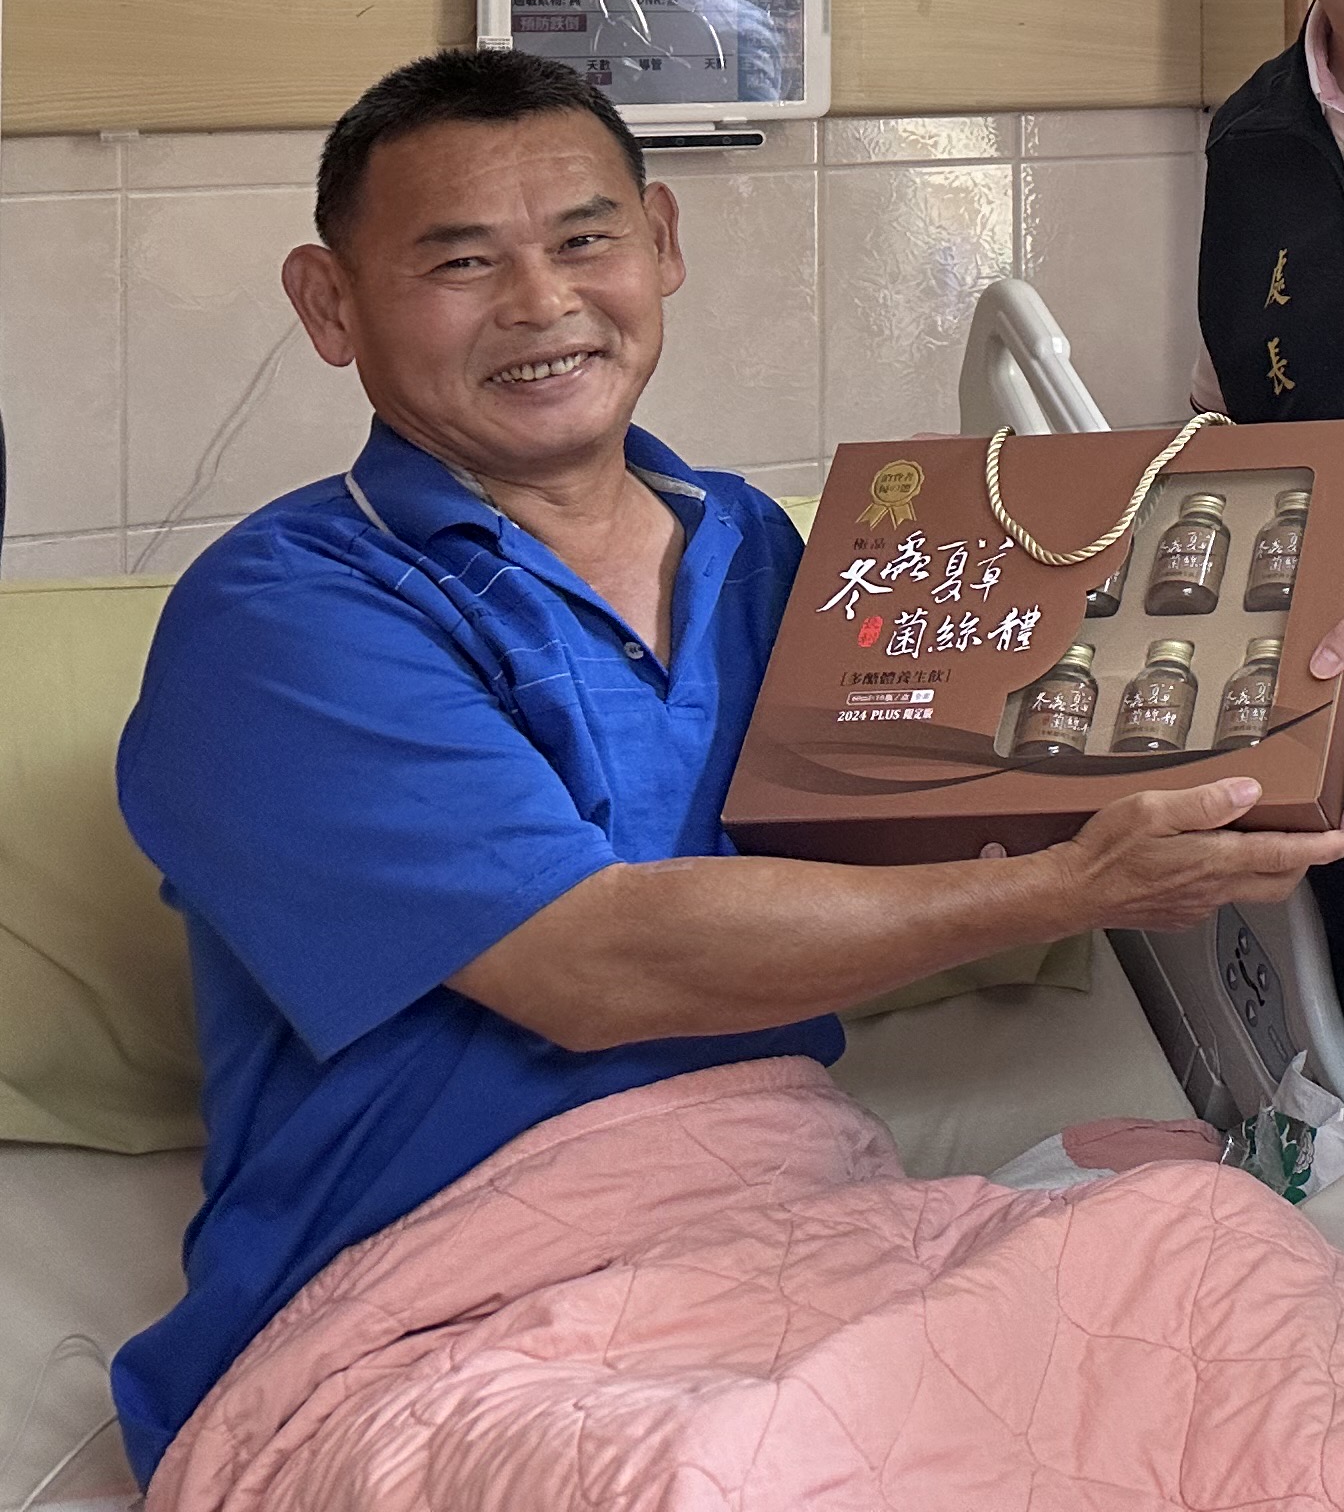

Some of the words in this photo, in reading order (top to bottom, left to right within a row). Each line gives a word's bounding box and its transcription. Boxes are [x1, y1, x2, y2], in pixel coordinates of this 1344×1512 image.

[1264, 247, 1296, 396] 處長
[837, 709, 867, 723] 2024
[870, 708, 902, 721] PLUS
